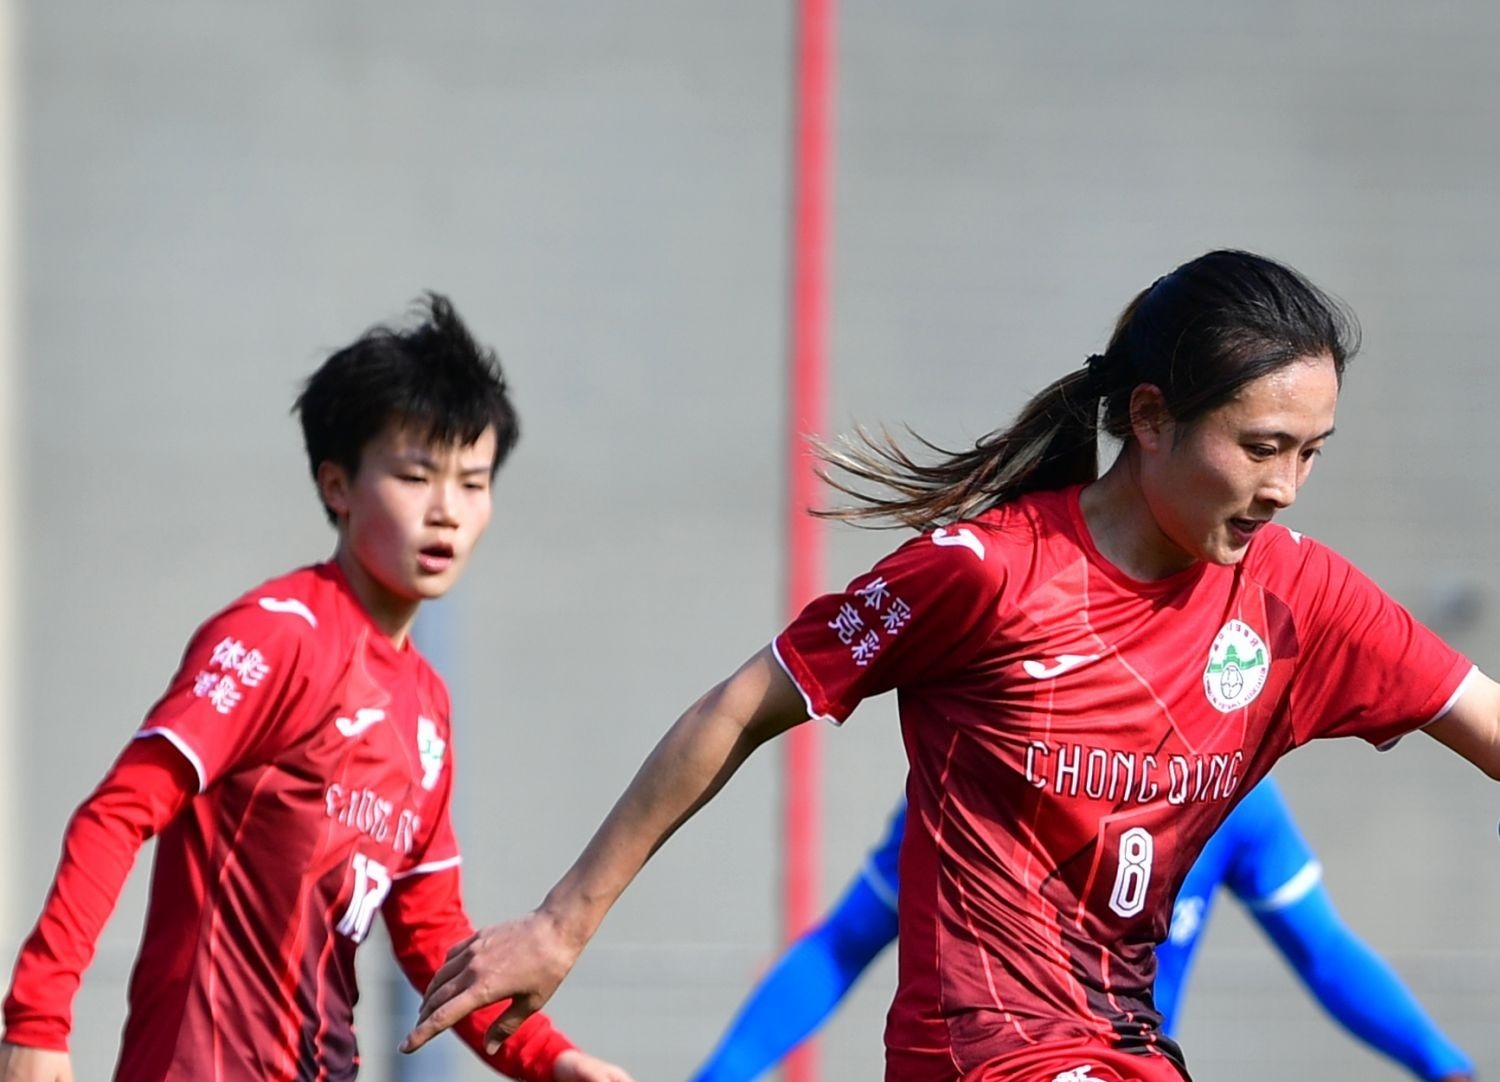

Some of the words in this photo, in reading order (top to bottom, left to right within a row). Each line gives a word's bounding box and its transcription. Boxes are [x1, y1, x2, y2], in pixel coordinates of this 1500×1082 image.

[827, 602, 880, 666] 竞彩
[854, 576, 911, 635] 体彩
[1108, 827, 1153, 918] 8
